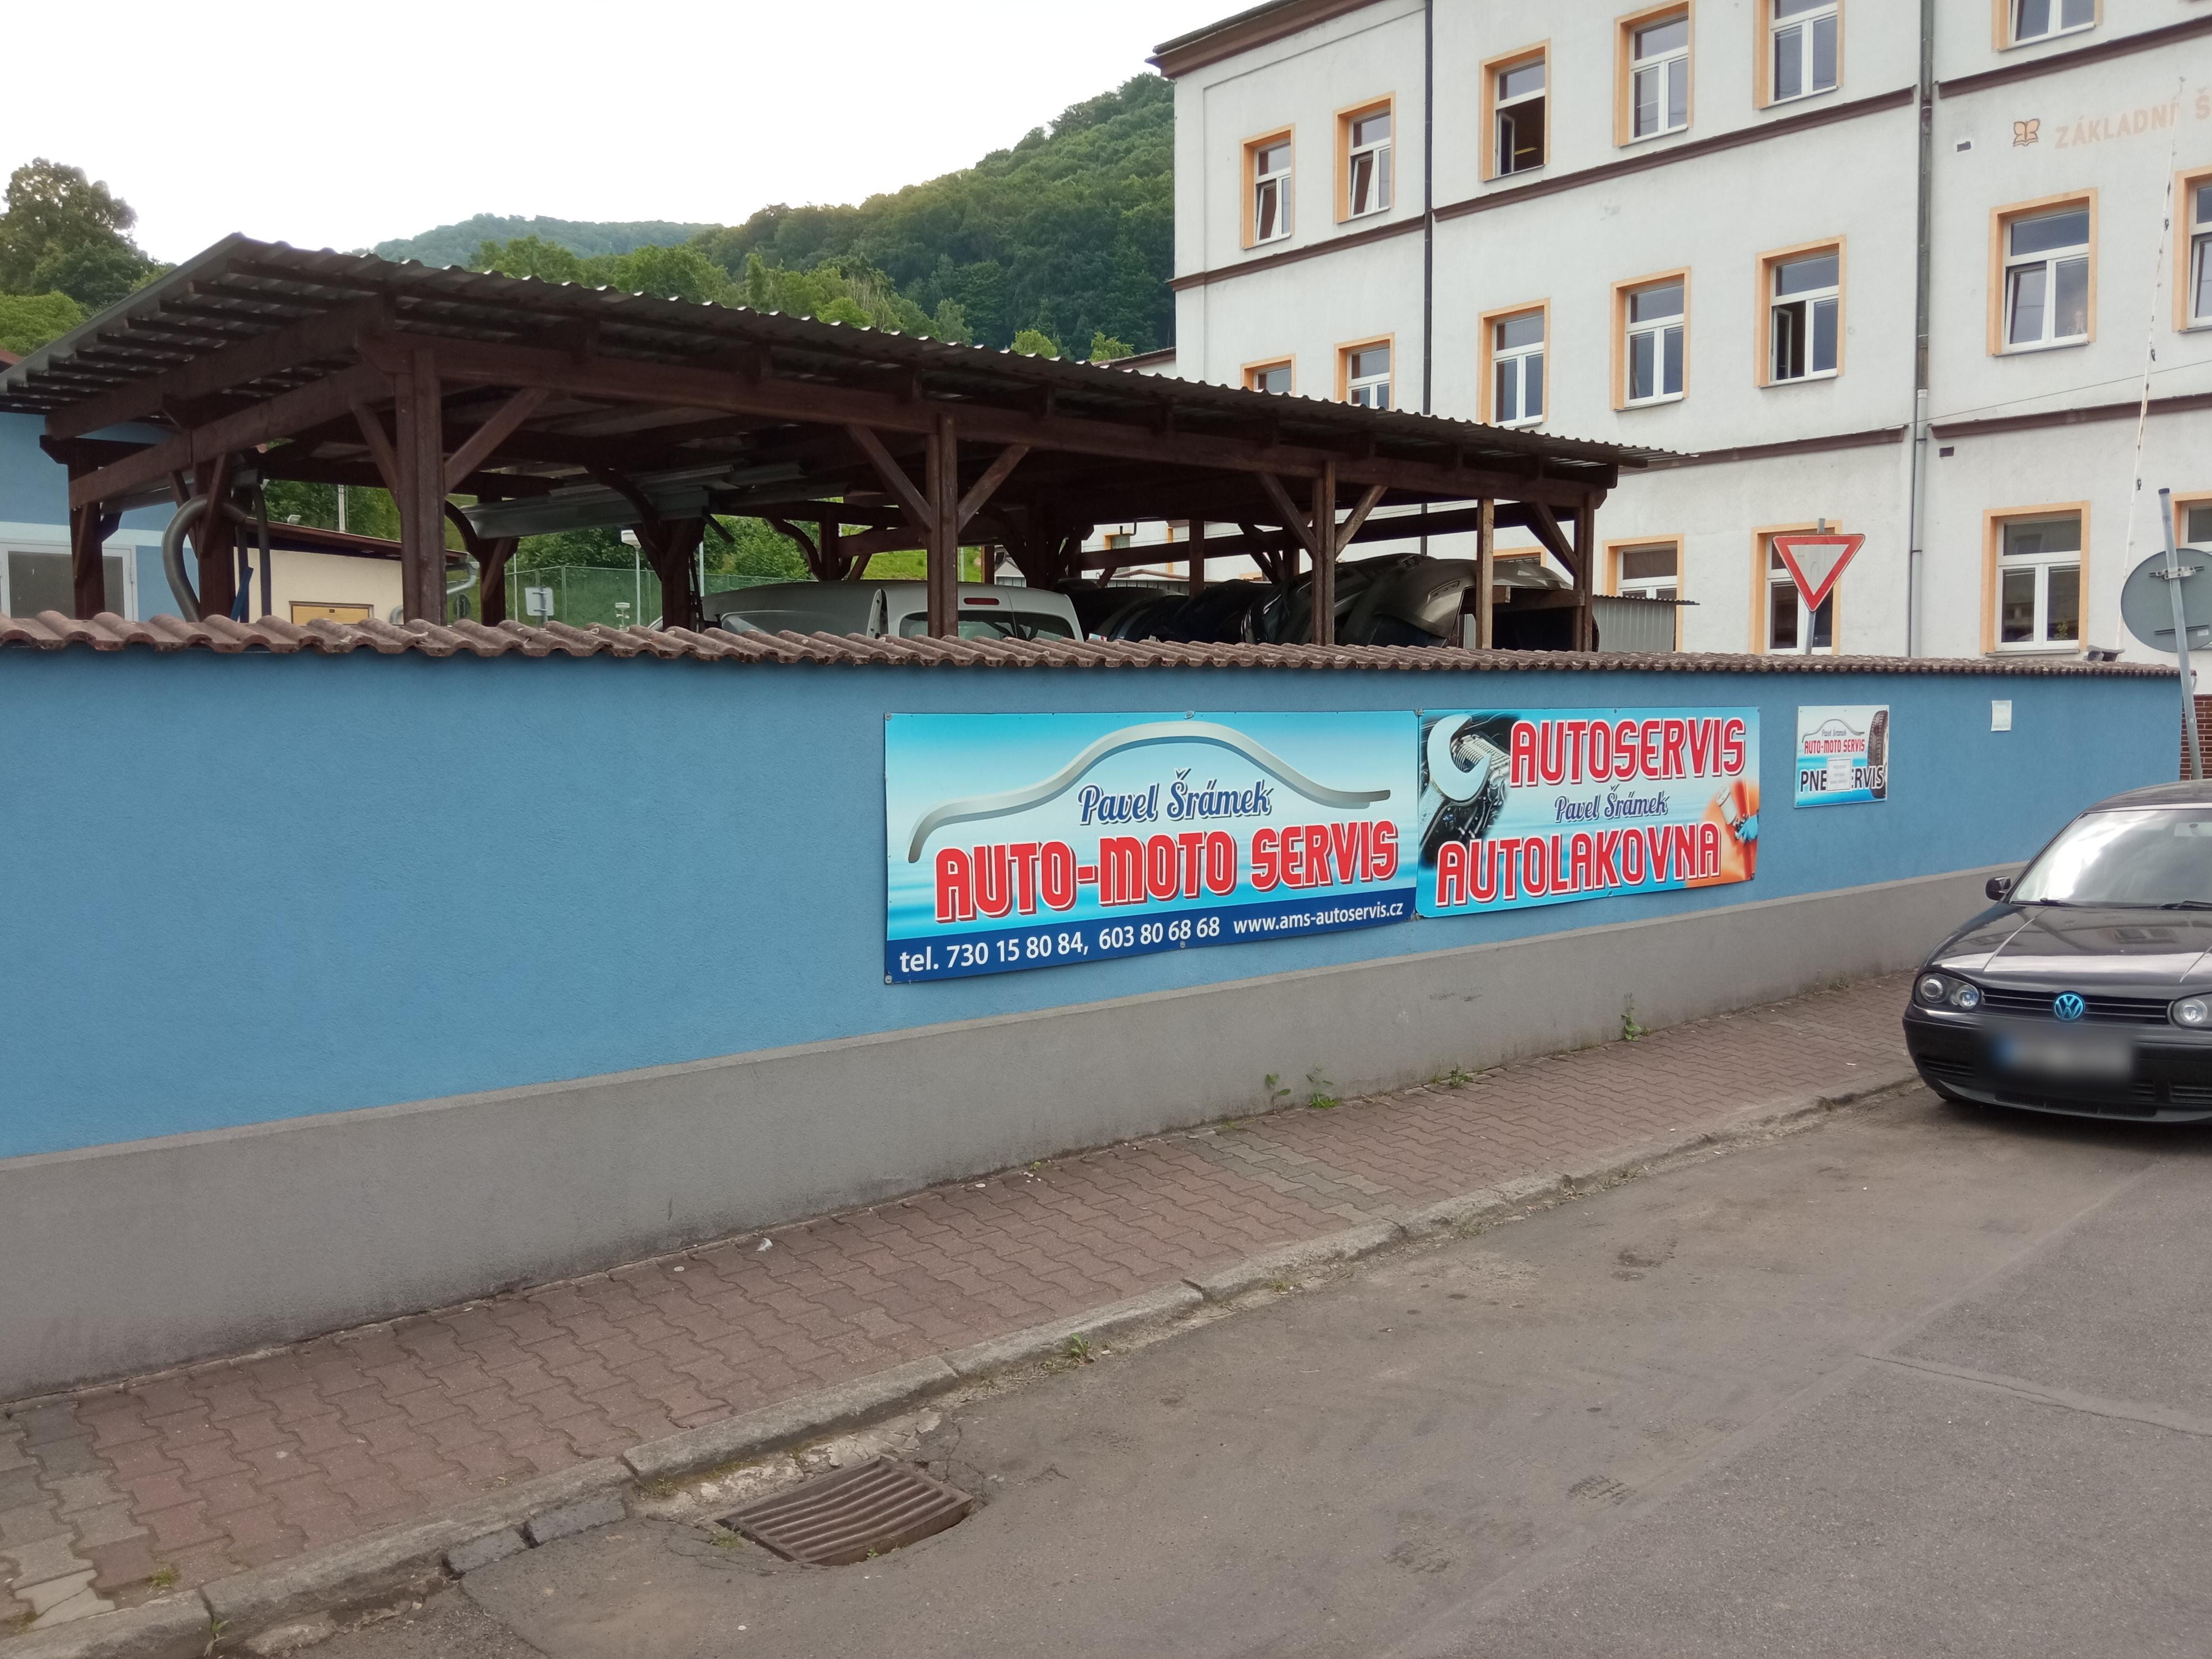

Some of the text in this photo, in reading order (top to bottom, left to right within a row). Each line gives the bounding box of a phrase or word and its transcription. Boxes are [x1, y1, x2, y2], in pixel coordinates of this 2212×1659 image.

[2054, 95, 2178, 149] ZÁKLADNÍ
[1510, 717, 1747, 788] AUTOSERVIS
[1804, 738, 1865, 754] AUTO-MOTO SERVIS
[1077, 768, 1274, 826] Pavel Šrámek
[1554, 784, 1670, 823] Pavel Šrámek
[1800, 766, 1884, 792] PNERVIS
[935, 820, 1398, 923] AUTO-MOTO SERVIS
[1435, 820, 1722, 907] AUTOLAKOVNA
[900, 901, 1404, 973] tel. 730 15 80 84, 603 80 68 68 www.ams-autoservis.cz
